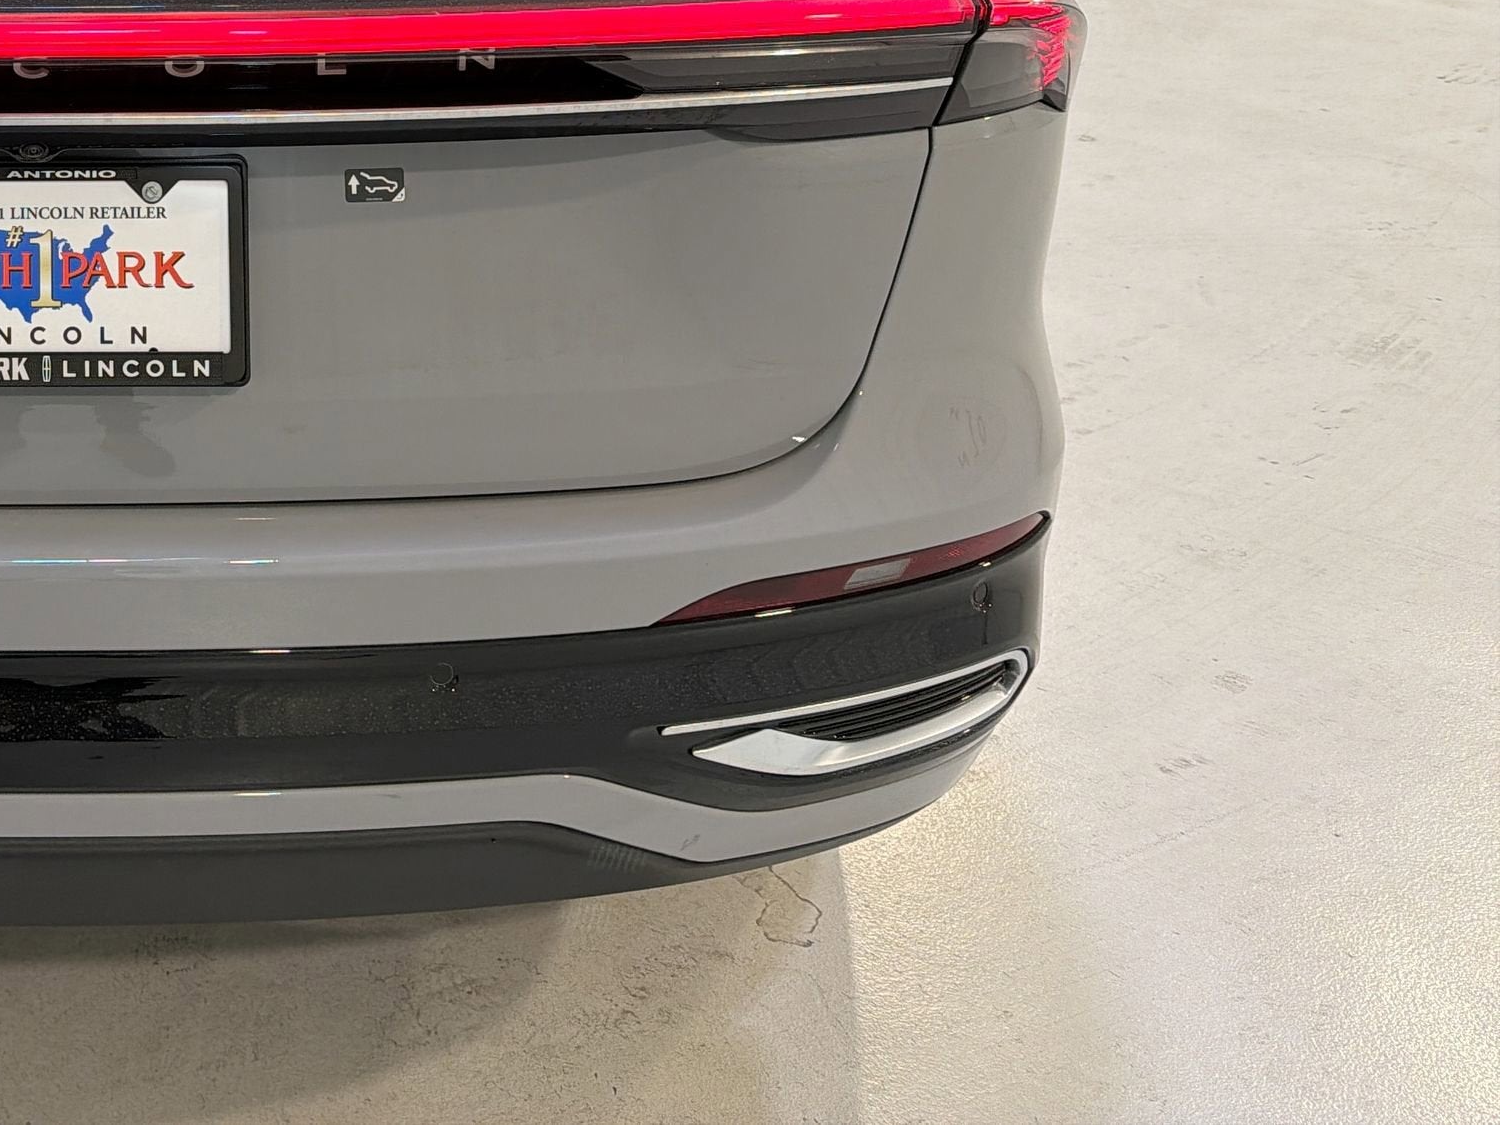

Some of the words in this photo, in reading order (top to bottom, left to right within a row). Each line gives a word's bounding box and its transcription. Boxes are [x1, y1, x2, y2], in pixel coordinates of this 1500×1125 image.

[7, 170, 116, 179] ANTONIO
[10, 207, 85, 220] LINCOLN
[89, 207, 168, 219] RETAILER
[60, 251, 195, 289] PARK
[62, 359, 210, 378] LINCOLN
